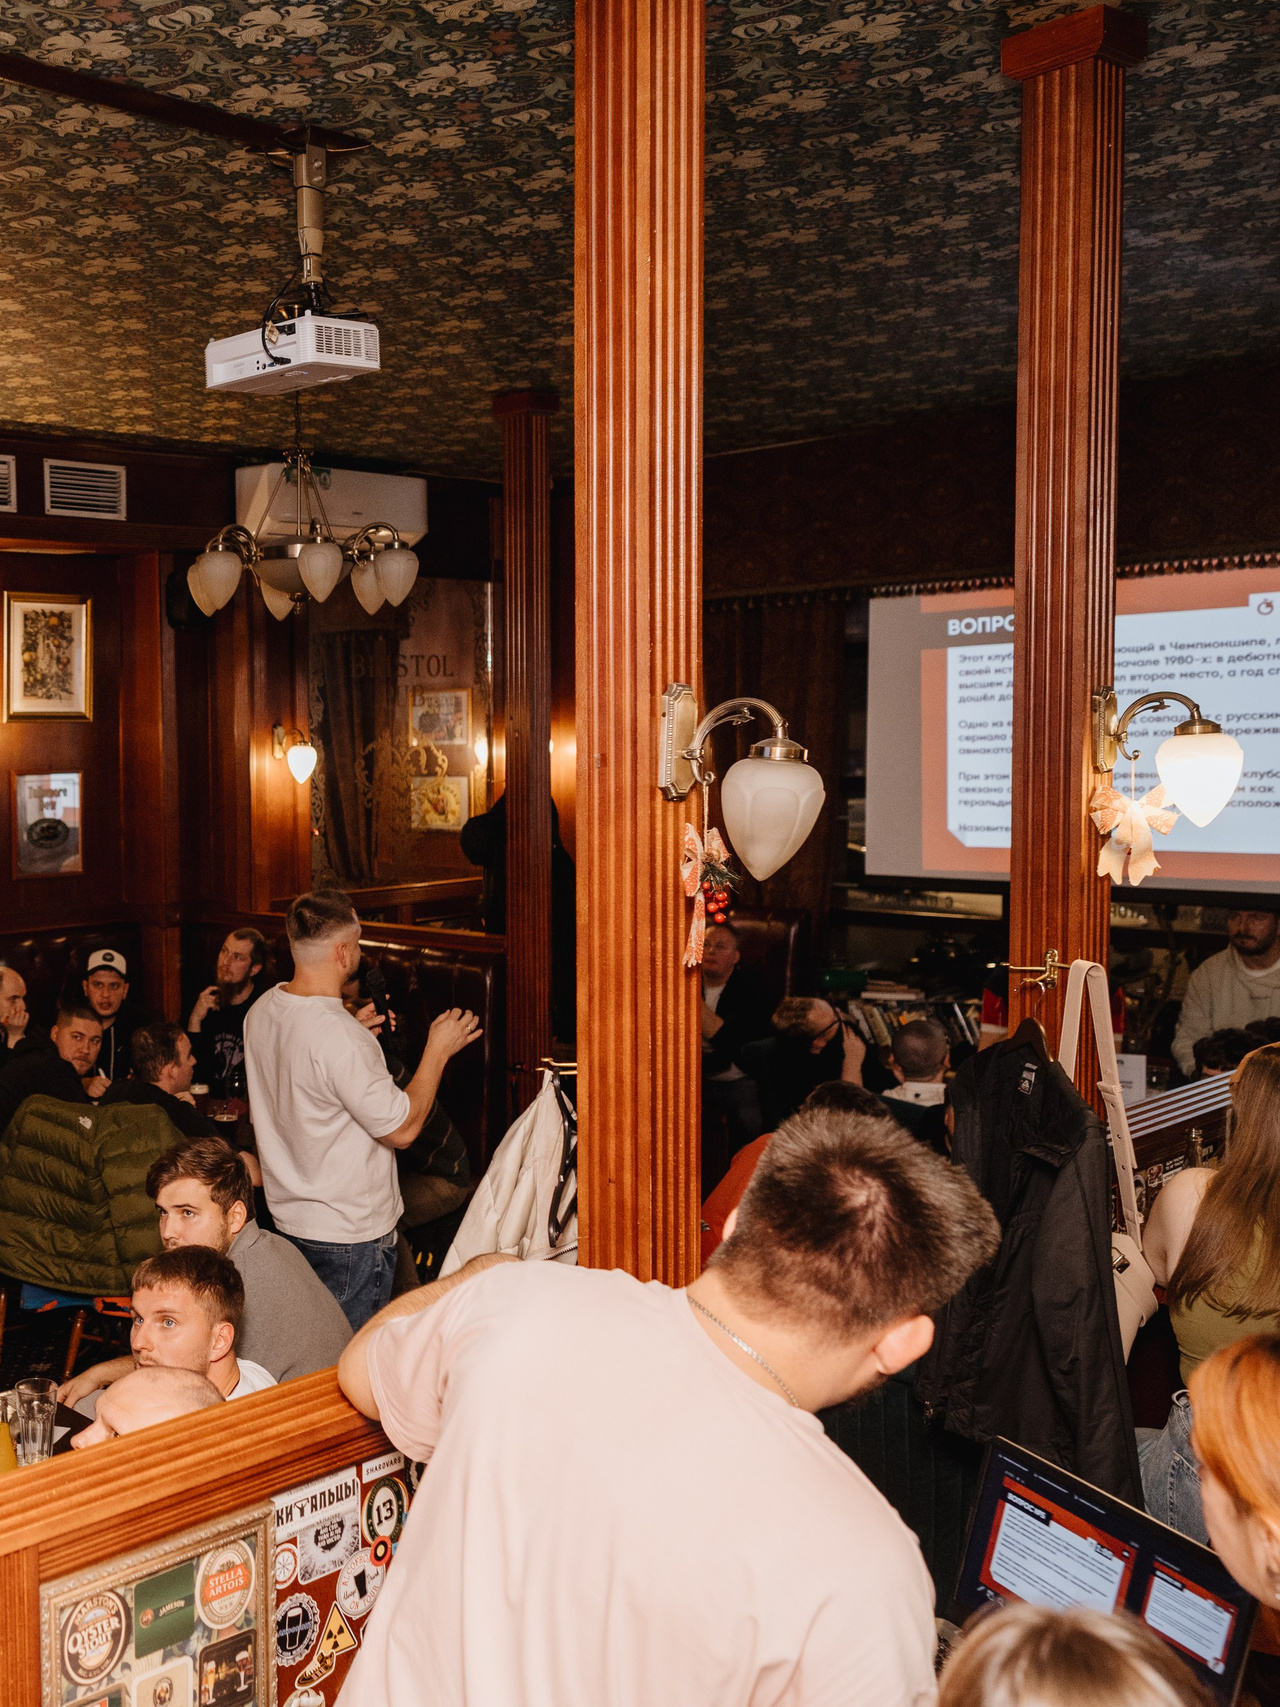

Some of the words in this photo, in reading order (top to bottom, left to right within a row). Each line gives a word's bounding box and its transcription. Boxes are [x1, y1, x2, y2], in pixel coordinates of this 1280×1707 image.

[959, 653, 984, 663] Этот
[1170, 637, 1271, 650] Чемпионшипе,
[352, 654, 455, 678] BRSTOL
[959, 666, 991, 677] своей
[959, 681, 1003, 690] высшем
[1130, 671, 1175, 683] второе
[1180, 670, 1223, 681] место,
[1240, 668, 1264, 678] год
[959, 693, 995, 704] дошёл
[959, 720, 989, 729] Одно
[1215, 713, 1222, 721] с
[959, 733, 1007, 743] сериала
[959, 771, 980, 781] При
[984, 773, 1010, 781] этом
[959, 786, 1004, 794] связано
[1250, 785, 1275, 793] как
[365, 1456, 402, 1476] SHAROVARS
[375, 1498, 395, 1527] 13
[208, 1576, 244, 1599] ARTOIS
[209, 1568, 243, 1589] STELLA
[158, 1599, 186, 1617] JAMESON
[349, 1600, 360, 1610] ON
[363, 1585, 379, 1607] TOUR
[68, 1616, 121, 1654] OYSTER
[78, 1630, 113, 1659] STOUT
